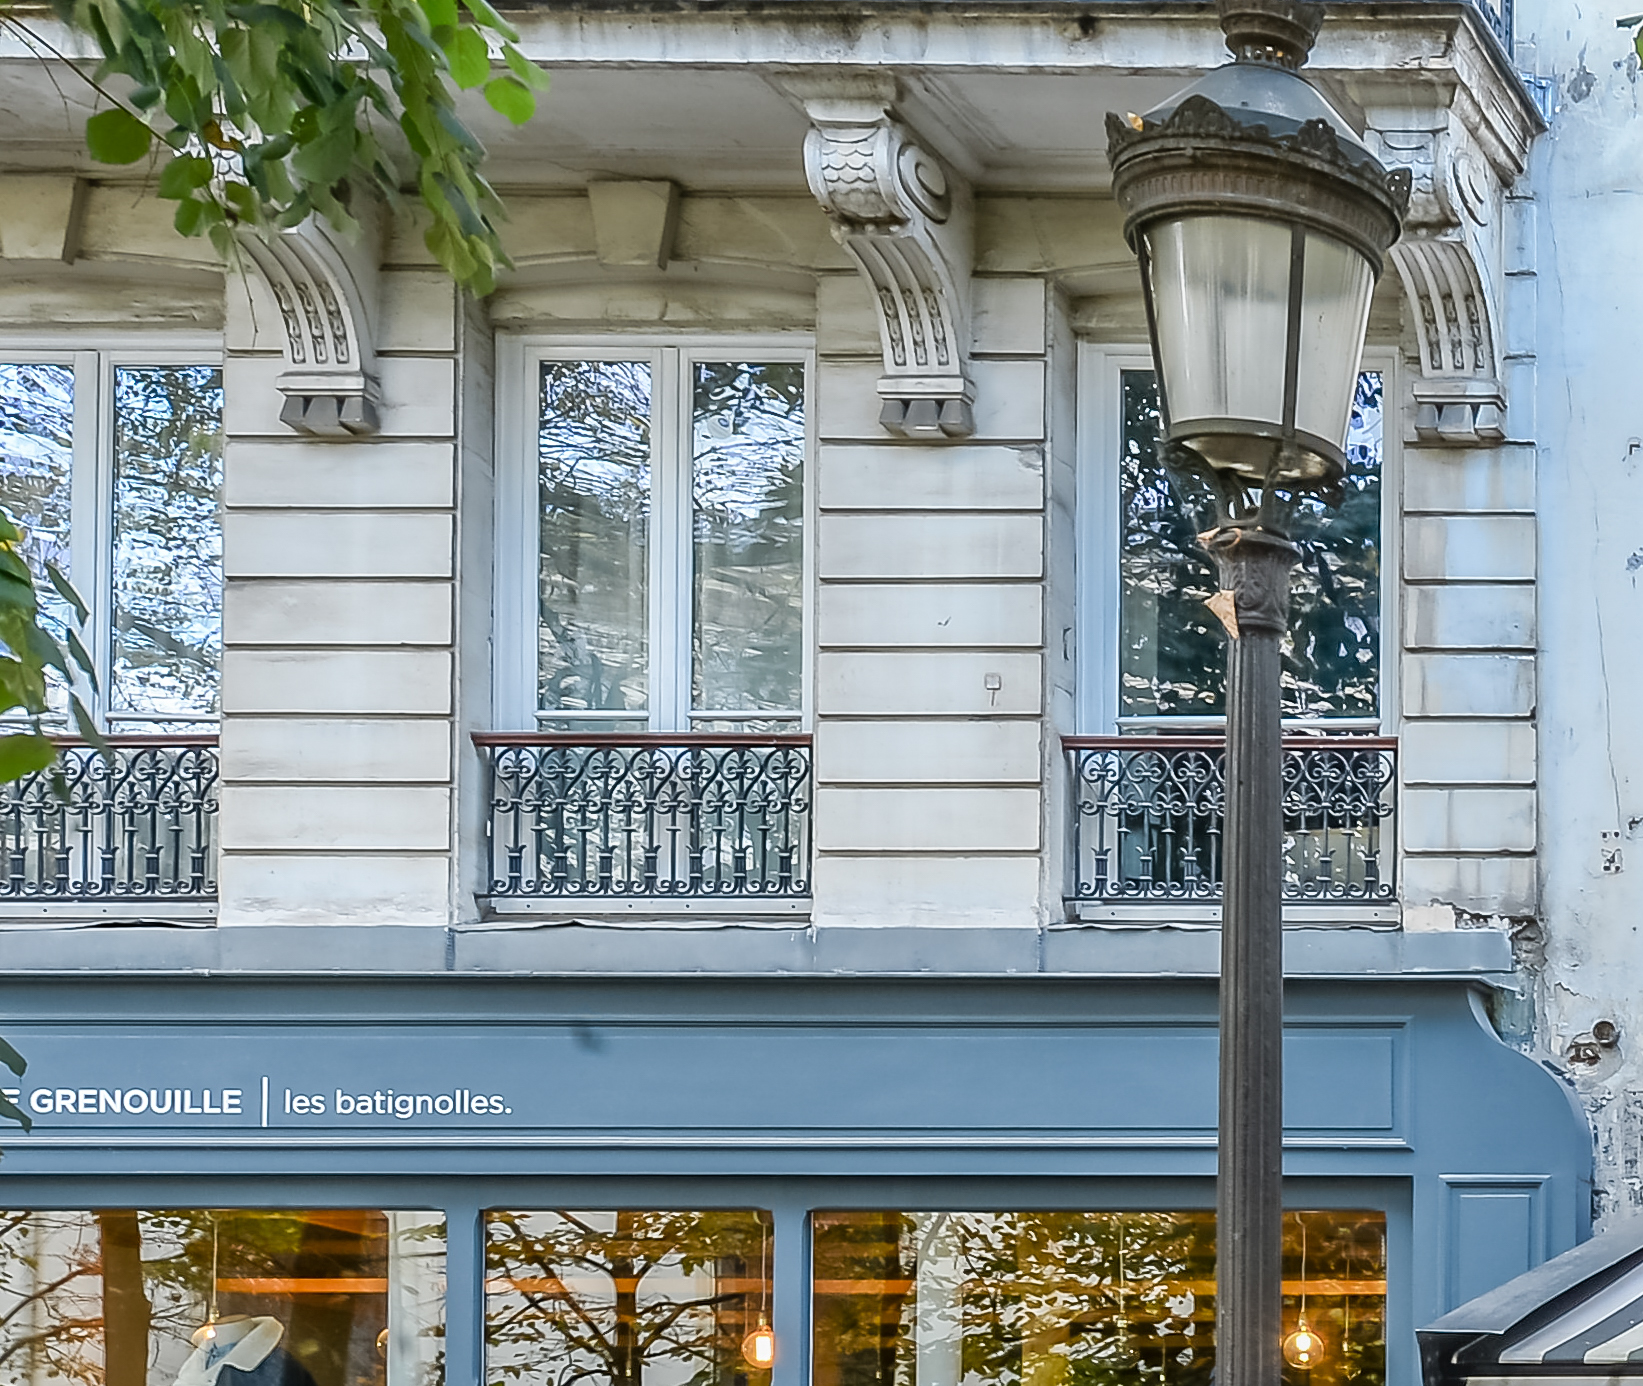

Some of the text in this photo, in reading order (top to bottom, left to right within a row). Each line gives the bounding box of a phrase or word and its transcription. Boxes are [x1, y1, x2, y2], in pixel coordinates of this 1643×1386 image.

[29, 1088, 243, 1114] GRENOUILLE
[284, 1088, 326, 1115] les
[335, 1088, 513, 1119] batignolles.
